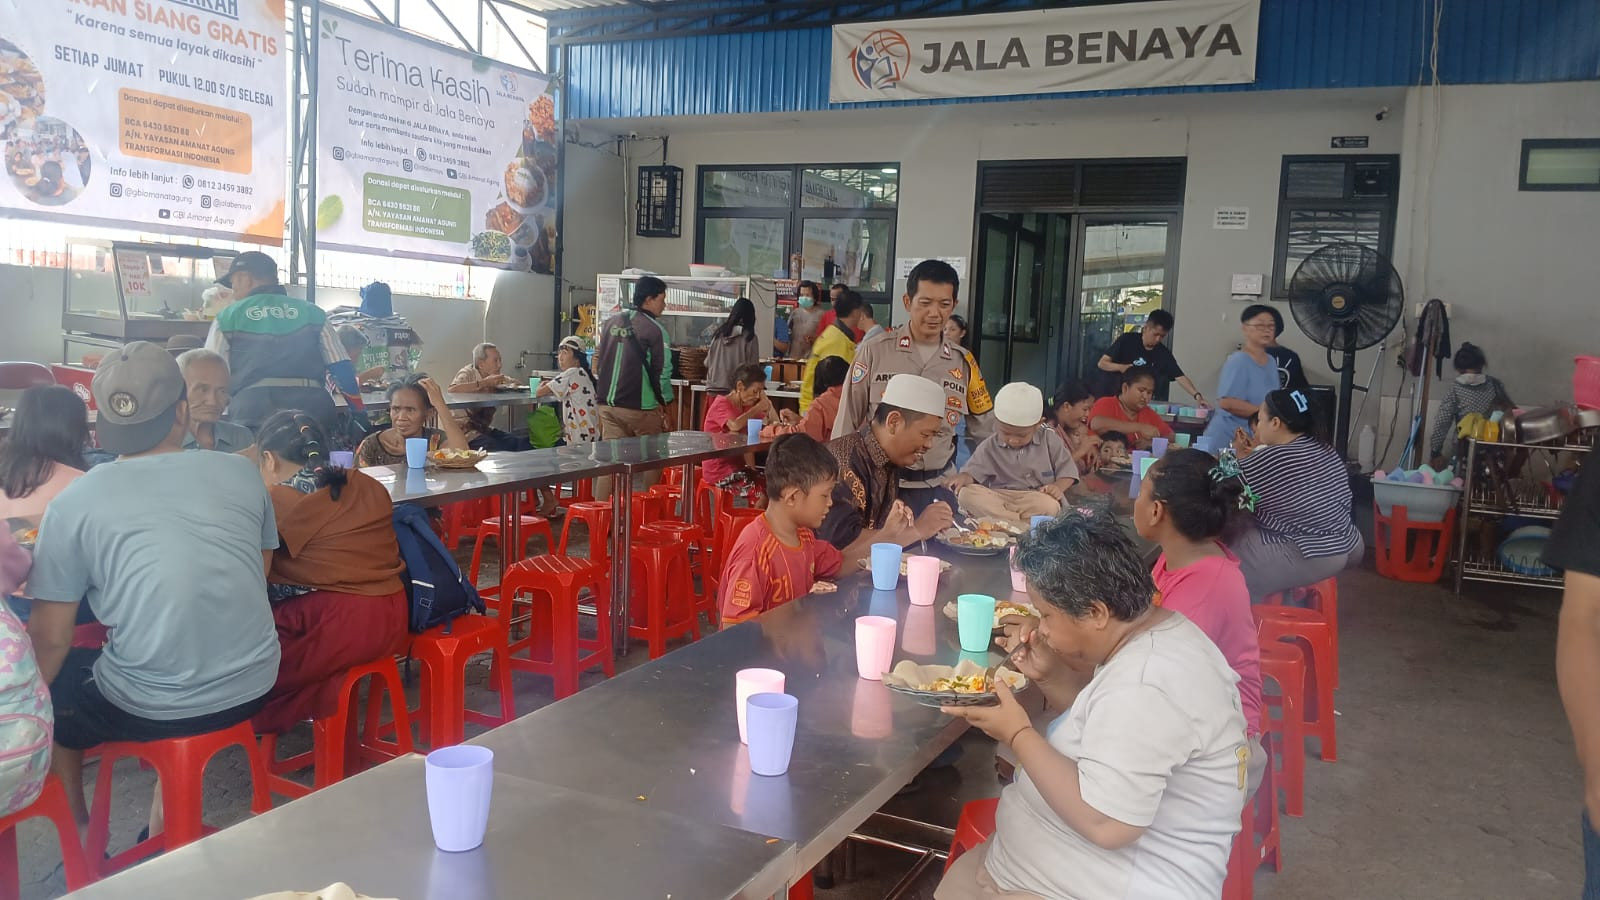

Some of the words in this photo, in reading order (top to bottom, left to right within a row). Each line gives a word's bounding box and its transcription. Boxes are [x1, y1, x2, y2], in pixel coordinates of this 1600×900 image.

[135, 2, 201, 35] SIANG
[207, 20, 278, 56] GRATIS
[129, 27, 173, 48] semua
[176, 35, 210, 57] layak
[920, 37, 1030, 74] JALA
[1044, 24, 1242, 66] BENAYA
[54, 44, 99, 68] SETIAP
[104, 56, 144, 78] JUMAT
[159, 69, 191, 88] PUKUL
[193, 76, 217, 94] 12.00
[219, 81, 236, 98] S/D
[238, 87, 274, 107] SELESAI
[335, 36, 424, 88] Terima
[430, 66, 491, 106] Kasih
[123, 93, 152, 105] Donasi
[153, 100, 176, 111] dapat
[336, 75, 376, 98] Sudah
[380, 90, 420, 111] mampir
[423, 101, 433, 113] di
[435, 103, 456, 119] Jala
[458, 109, 495, 130] Benaya
[125, 117, 141, 126] BCA
[413, 121, 427, 130] JALA
[124, 142, 183, 158] TRANSFORMASI
[183, 152, 221, 164] INDONESIA
[143, 131, 179, 145] YAYASAN
[180, 139, 210, 151] AMANAT
[211, 145, 236, 155] AGUNG
[110, 166, 127, 177] Info
[129, 169, 149, 180] lebih
[368, 177, 390, 187] Donasi
[197, 179, 216, 190] 0812
[217, 182, 235, 192] 3459
[245, 304, 299, 321] Grab
[773, 575, 790, 602] 21
